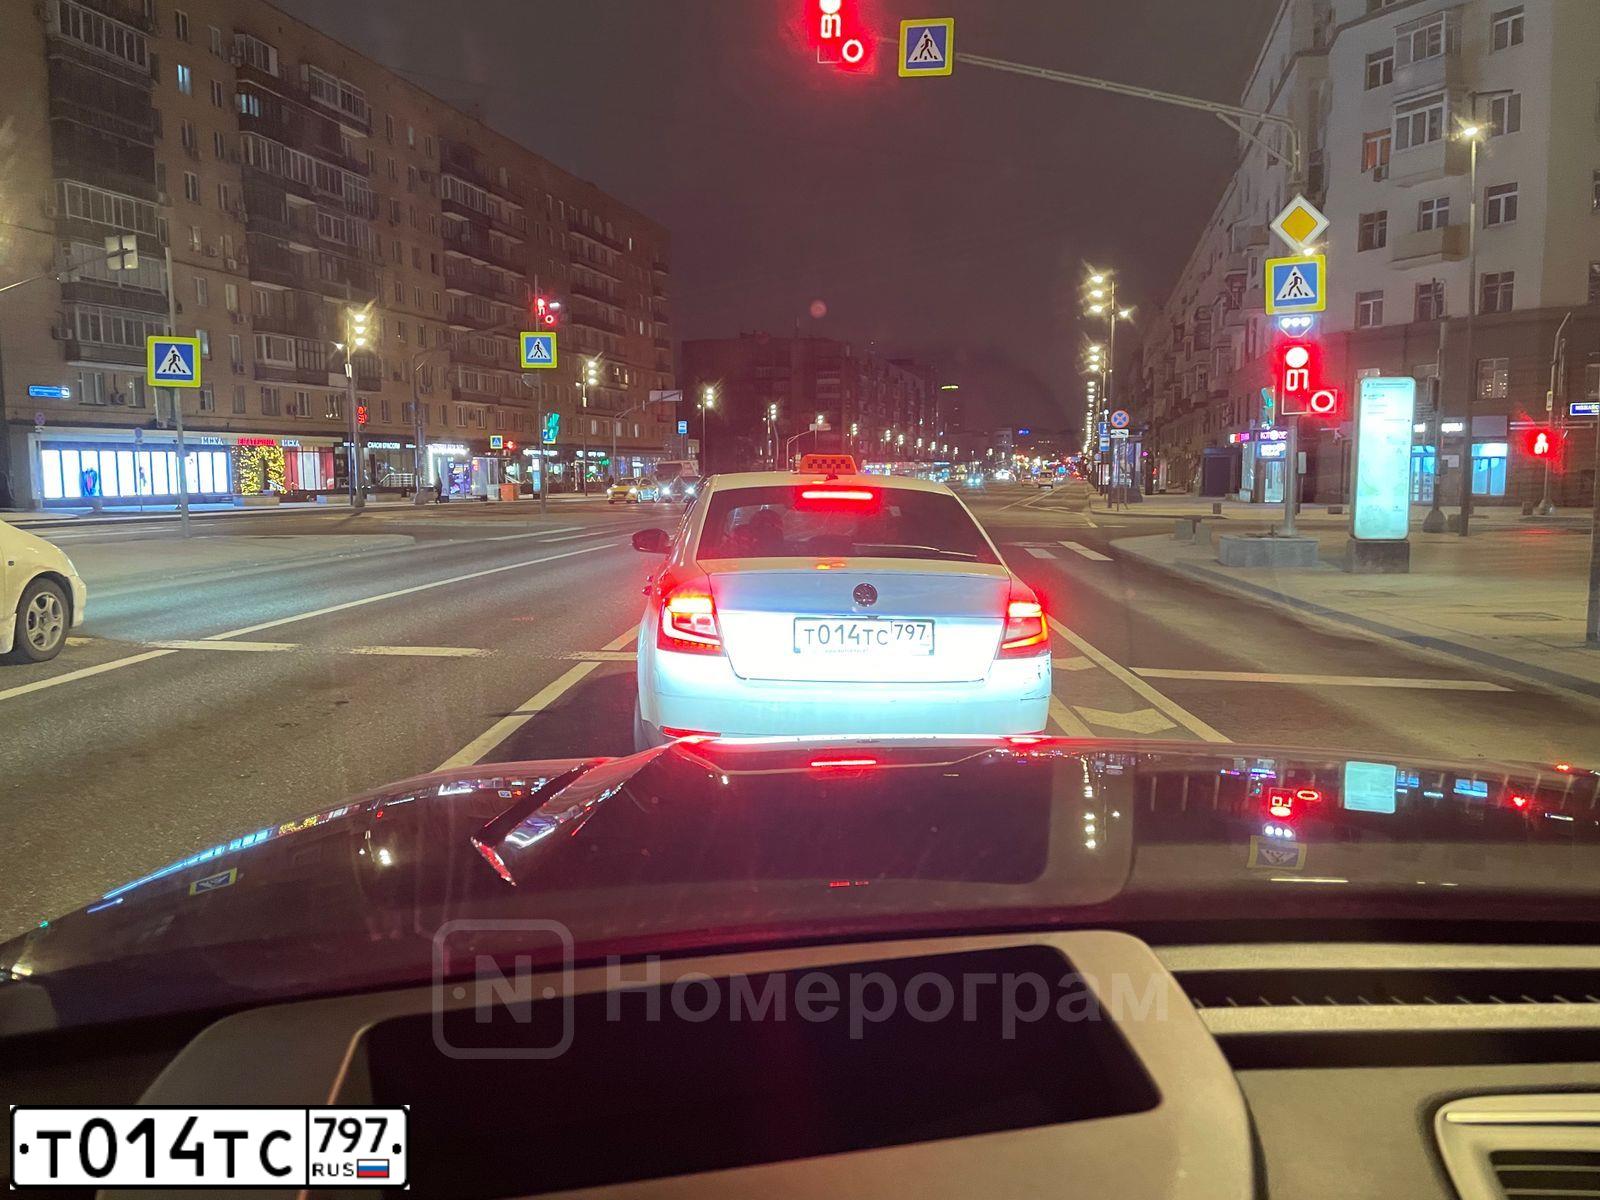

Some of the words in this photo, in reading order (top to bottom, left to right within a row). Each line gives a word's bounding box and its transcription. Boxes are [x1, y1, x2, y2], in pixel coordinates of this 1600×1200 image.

[1286, 368, 1309, 392] 07
[803, 624, 888, 646] Т014ТС
[894, 624, 927, 641] 797
